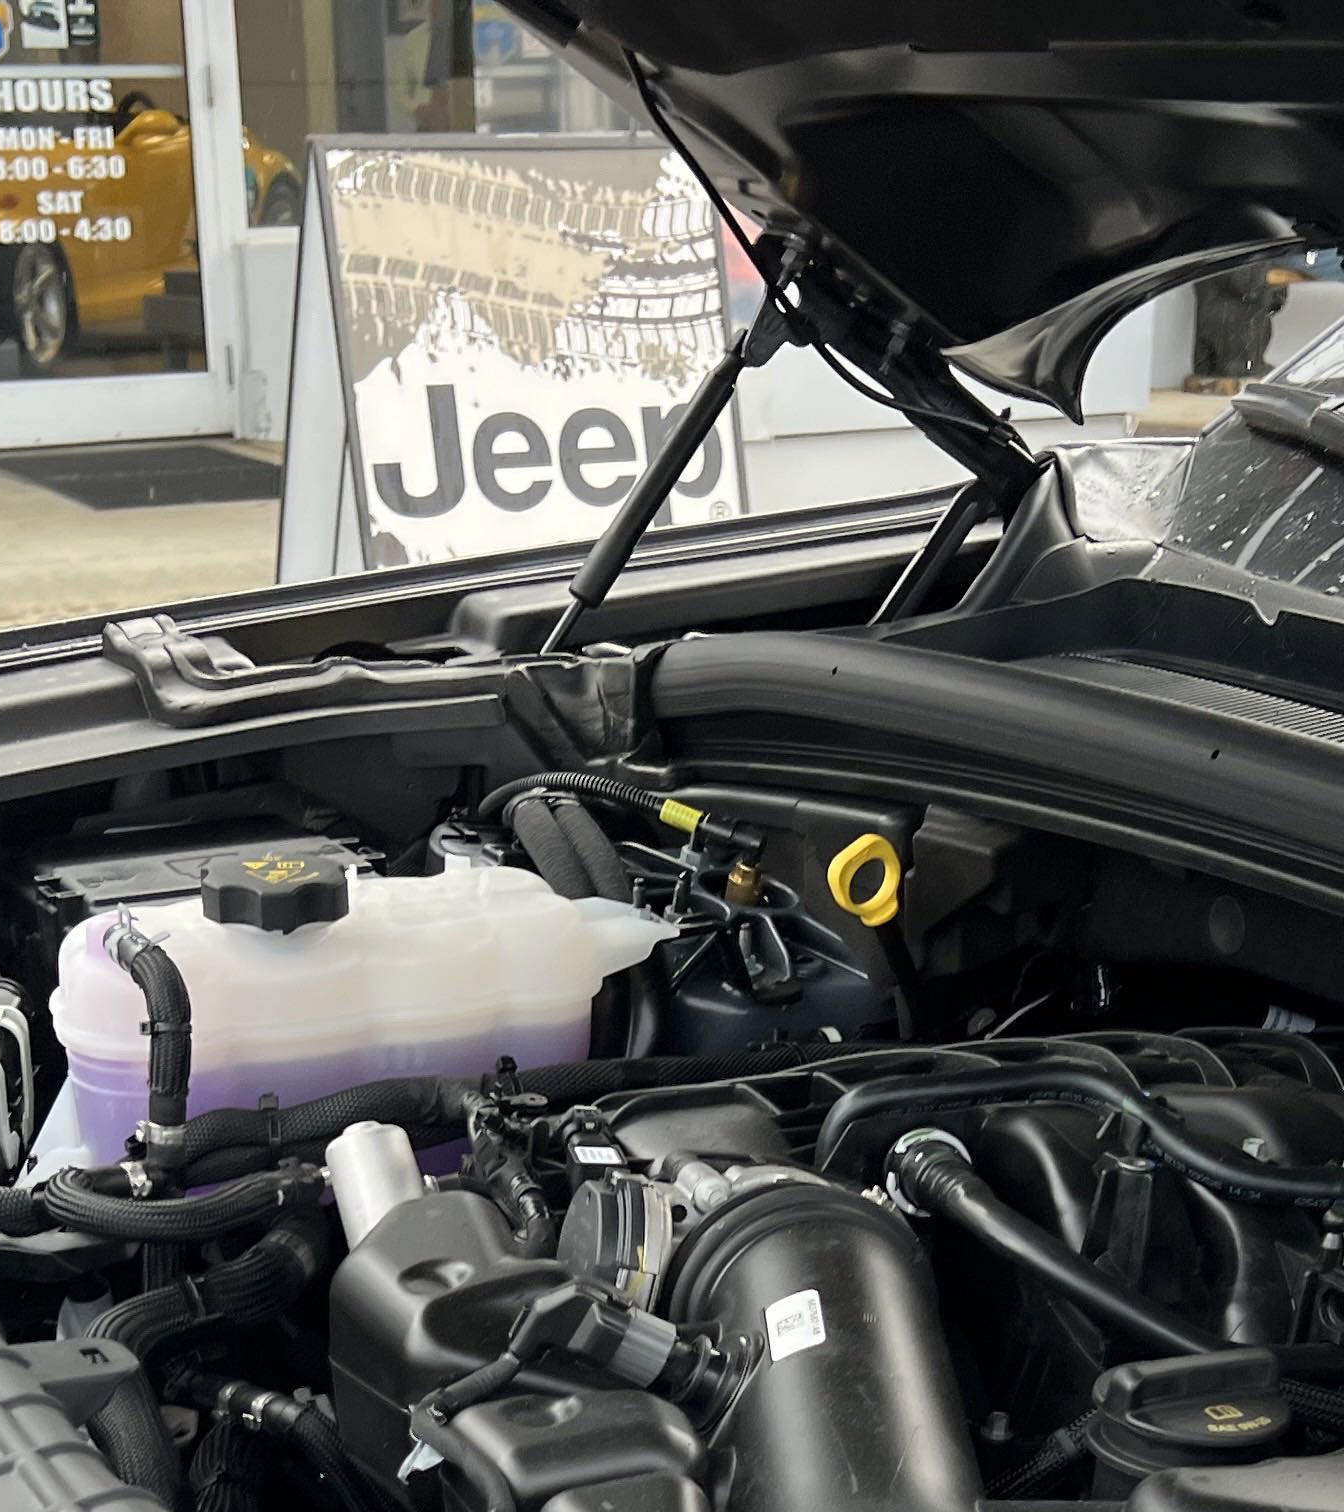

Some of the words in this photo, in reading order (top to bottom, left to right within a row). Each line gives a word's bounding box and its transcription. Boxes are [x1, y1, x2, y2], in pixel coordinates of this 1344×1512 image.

[73, 126, 115, 151] FRI
[67, 155, 126, 179] 6:30
[36, 190, 84, 215] SAT
[74, 217, 131, 241] 4:30
[372, 383, 723, 528] Jeep
